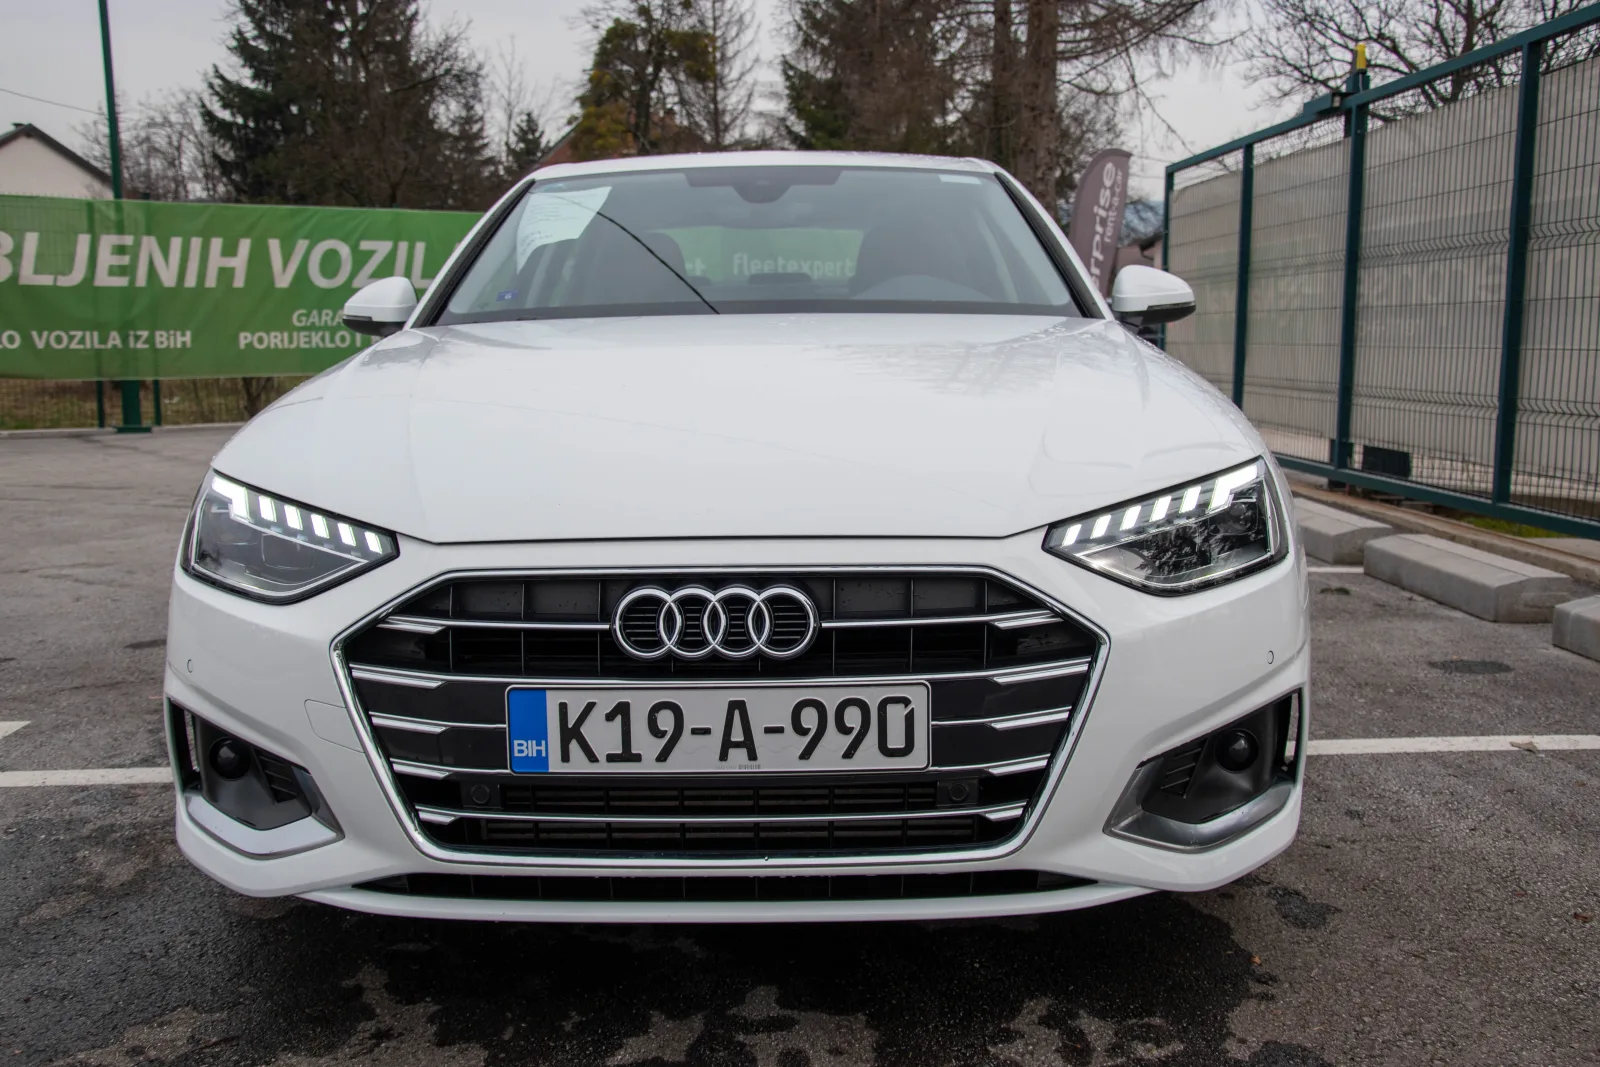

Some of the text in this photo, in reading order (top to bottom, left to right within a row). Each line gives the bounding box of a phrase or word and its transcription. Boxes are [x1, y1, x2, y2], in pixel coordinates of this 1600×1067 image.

[1104, 167, 1123, 243] rent-a-car
[268, 239, 461, 290] VOZIL
[733, 252, 857, 279] fleetexpert
[30, 330, 123, 349] VOZILA
[154, 330, 192, 349] BiH
[238, 330, 349, 349] PORIJEKLO
[557, 695, 916, 763] K19-A-990
[513, 739, 546, 757] BIH
